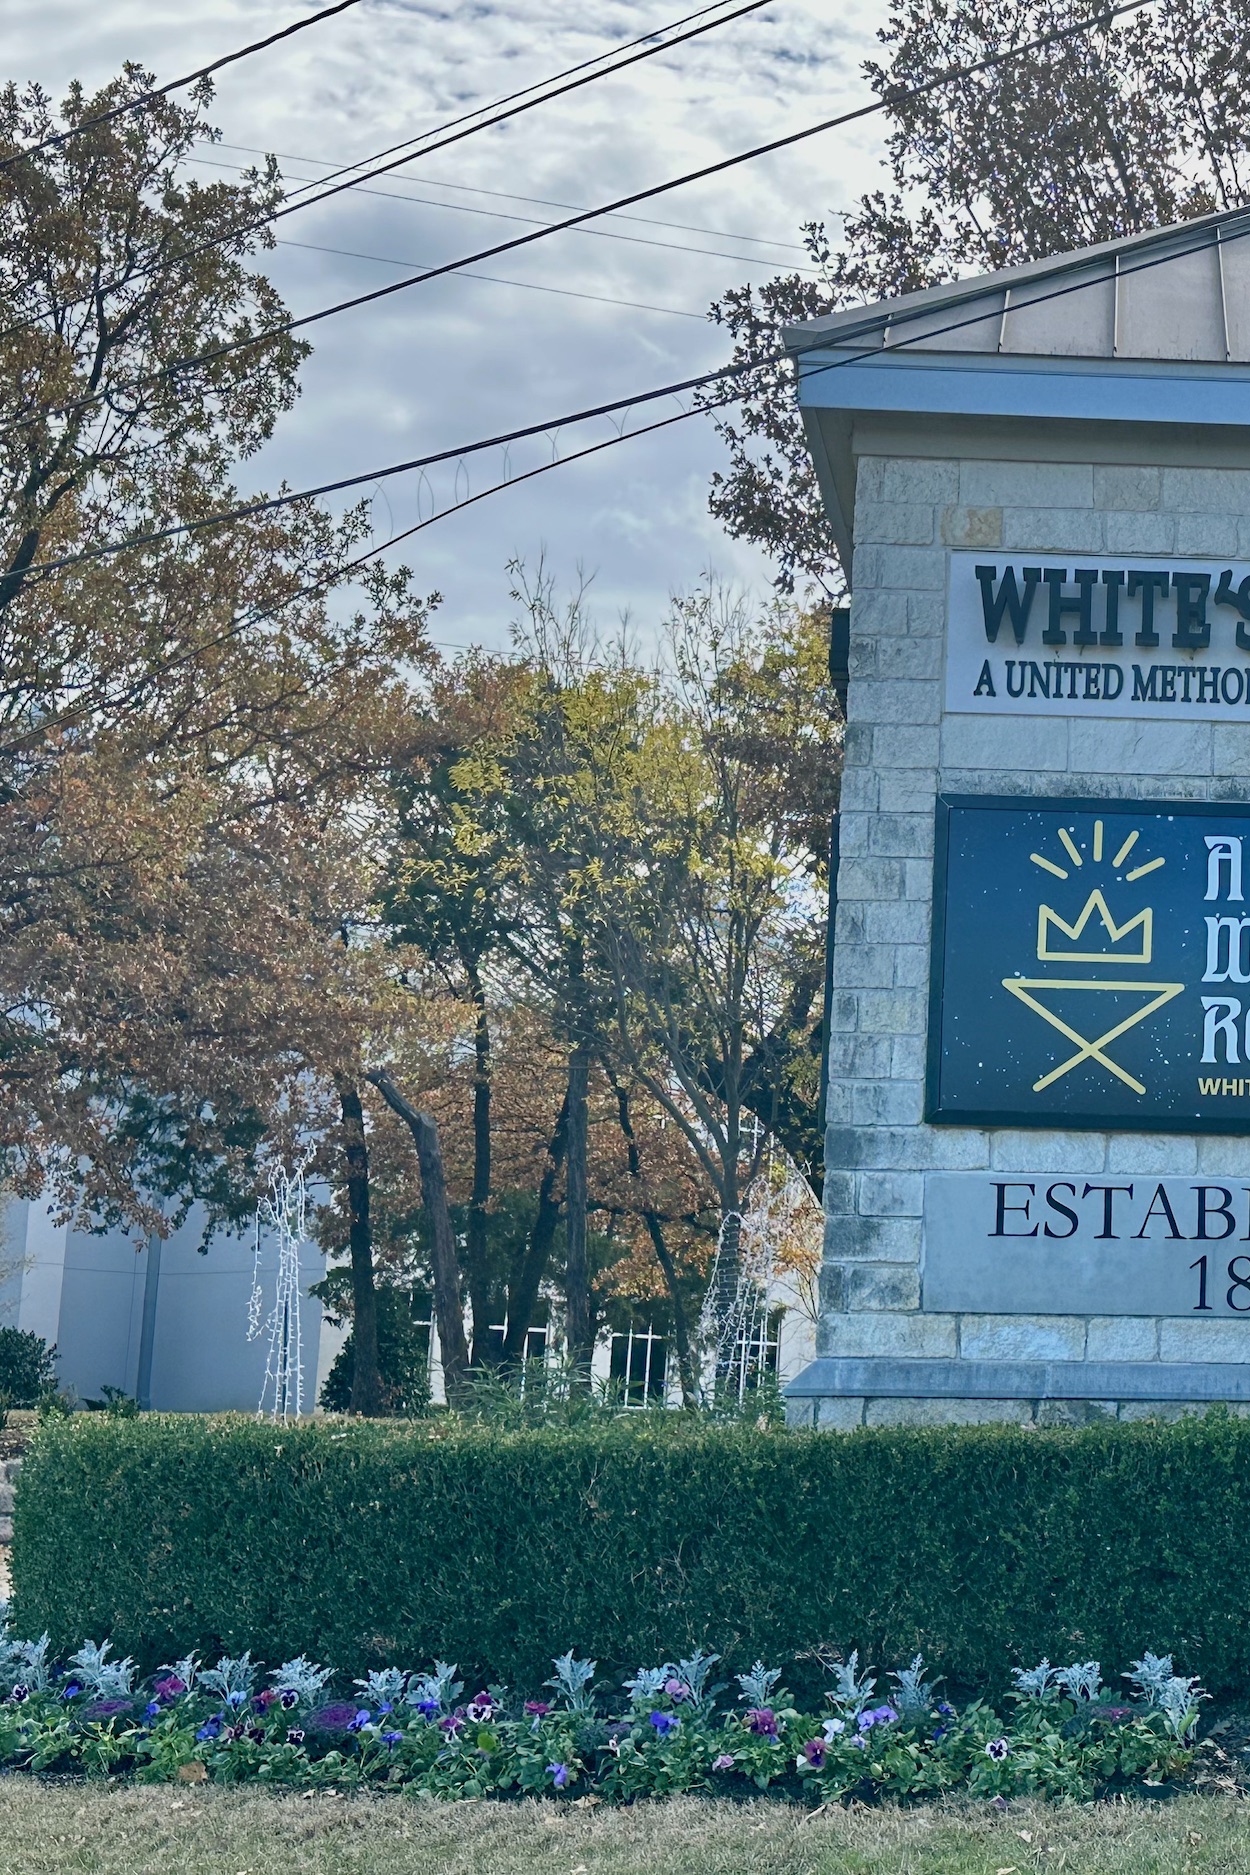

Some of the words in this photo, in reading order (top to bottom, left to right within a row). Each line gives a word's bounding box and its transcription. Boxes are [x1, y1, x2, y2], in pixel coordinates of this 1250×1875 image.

[973, 659, 997, 697] A
[1006, 661, 1123, 700] UNITED
[1203, 835, 1247, 903] A
